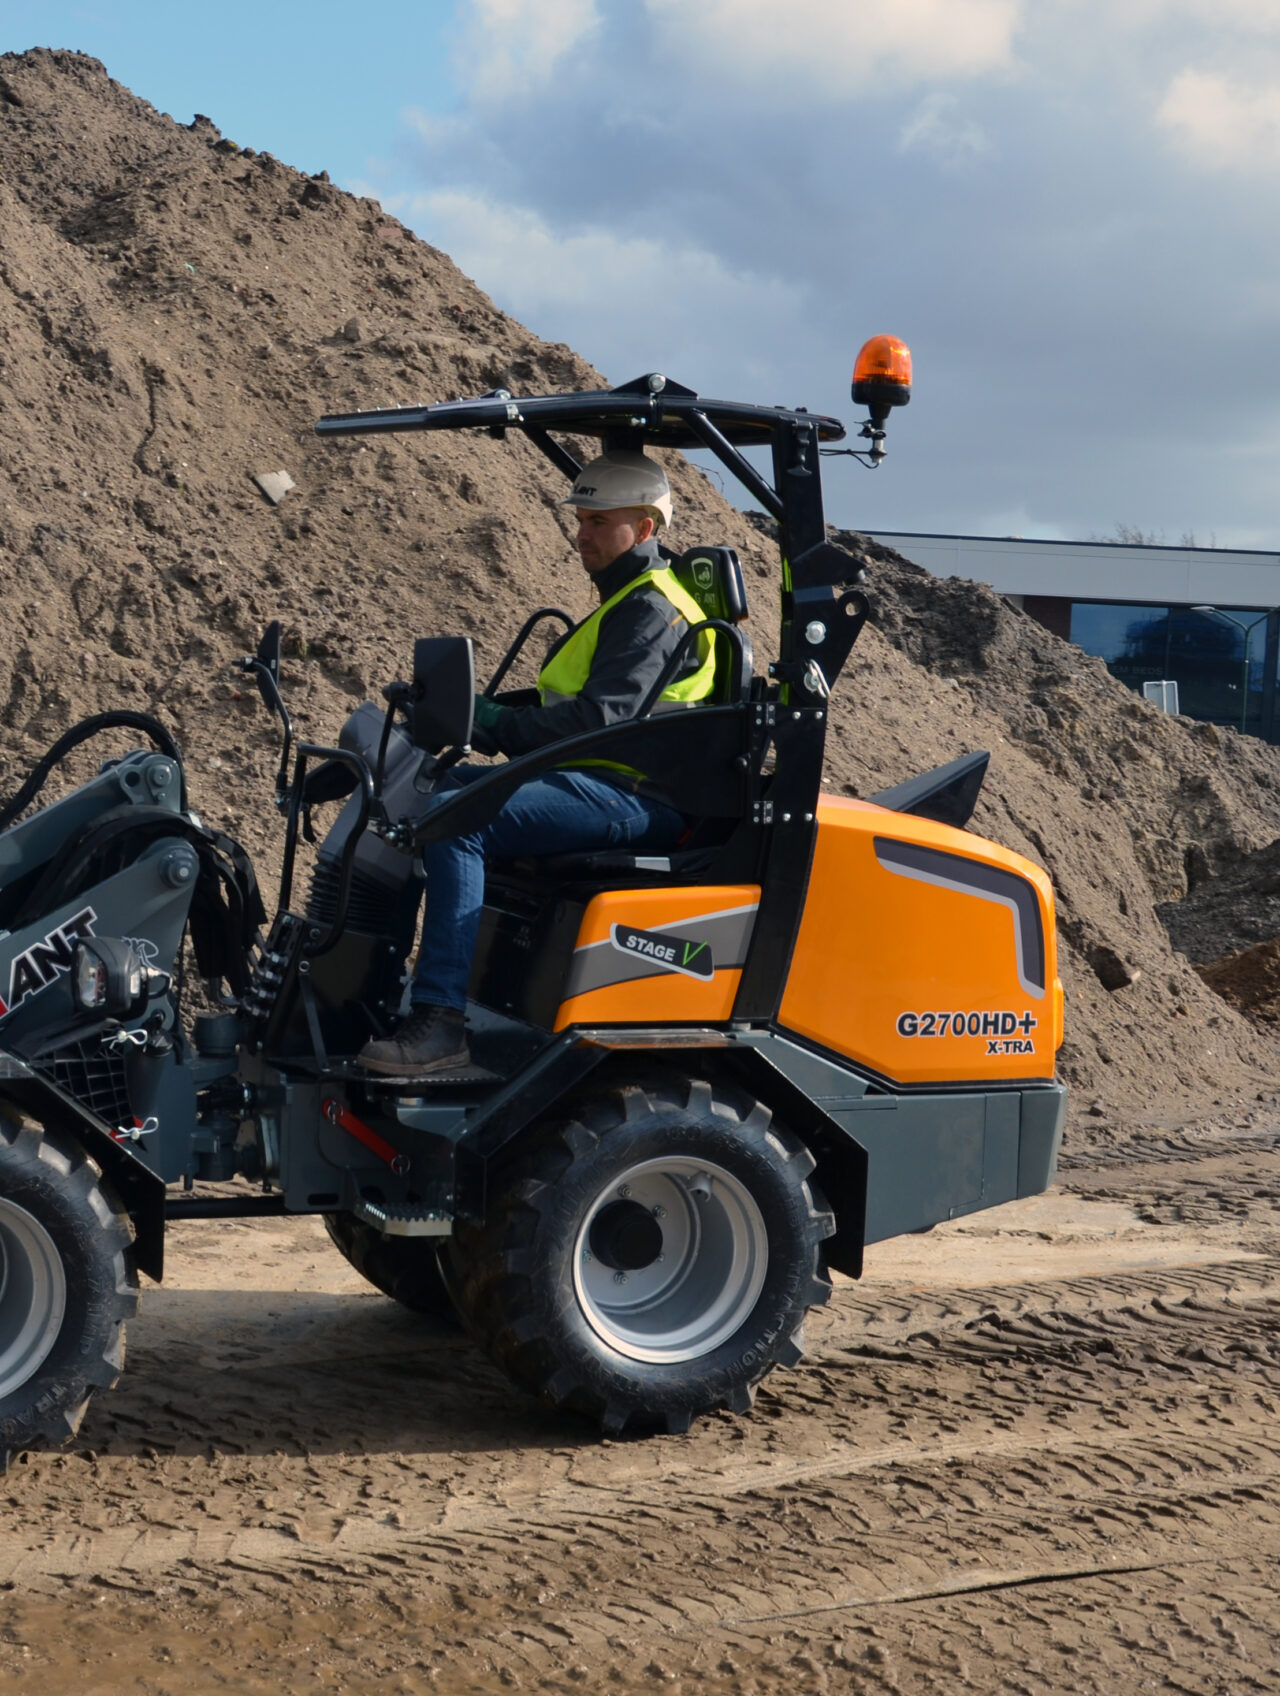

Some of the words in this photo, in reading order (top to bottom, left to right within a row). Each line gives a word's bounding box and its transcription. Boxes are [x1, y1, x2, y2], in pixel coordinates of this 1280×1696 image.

[626, 935, 676, 962] STAGE
[682, 940, 708, 966] V
[896, 1010, 1037, 1038] G2700HD+
[985, 1039, 1035, 1056] X-TRA
